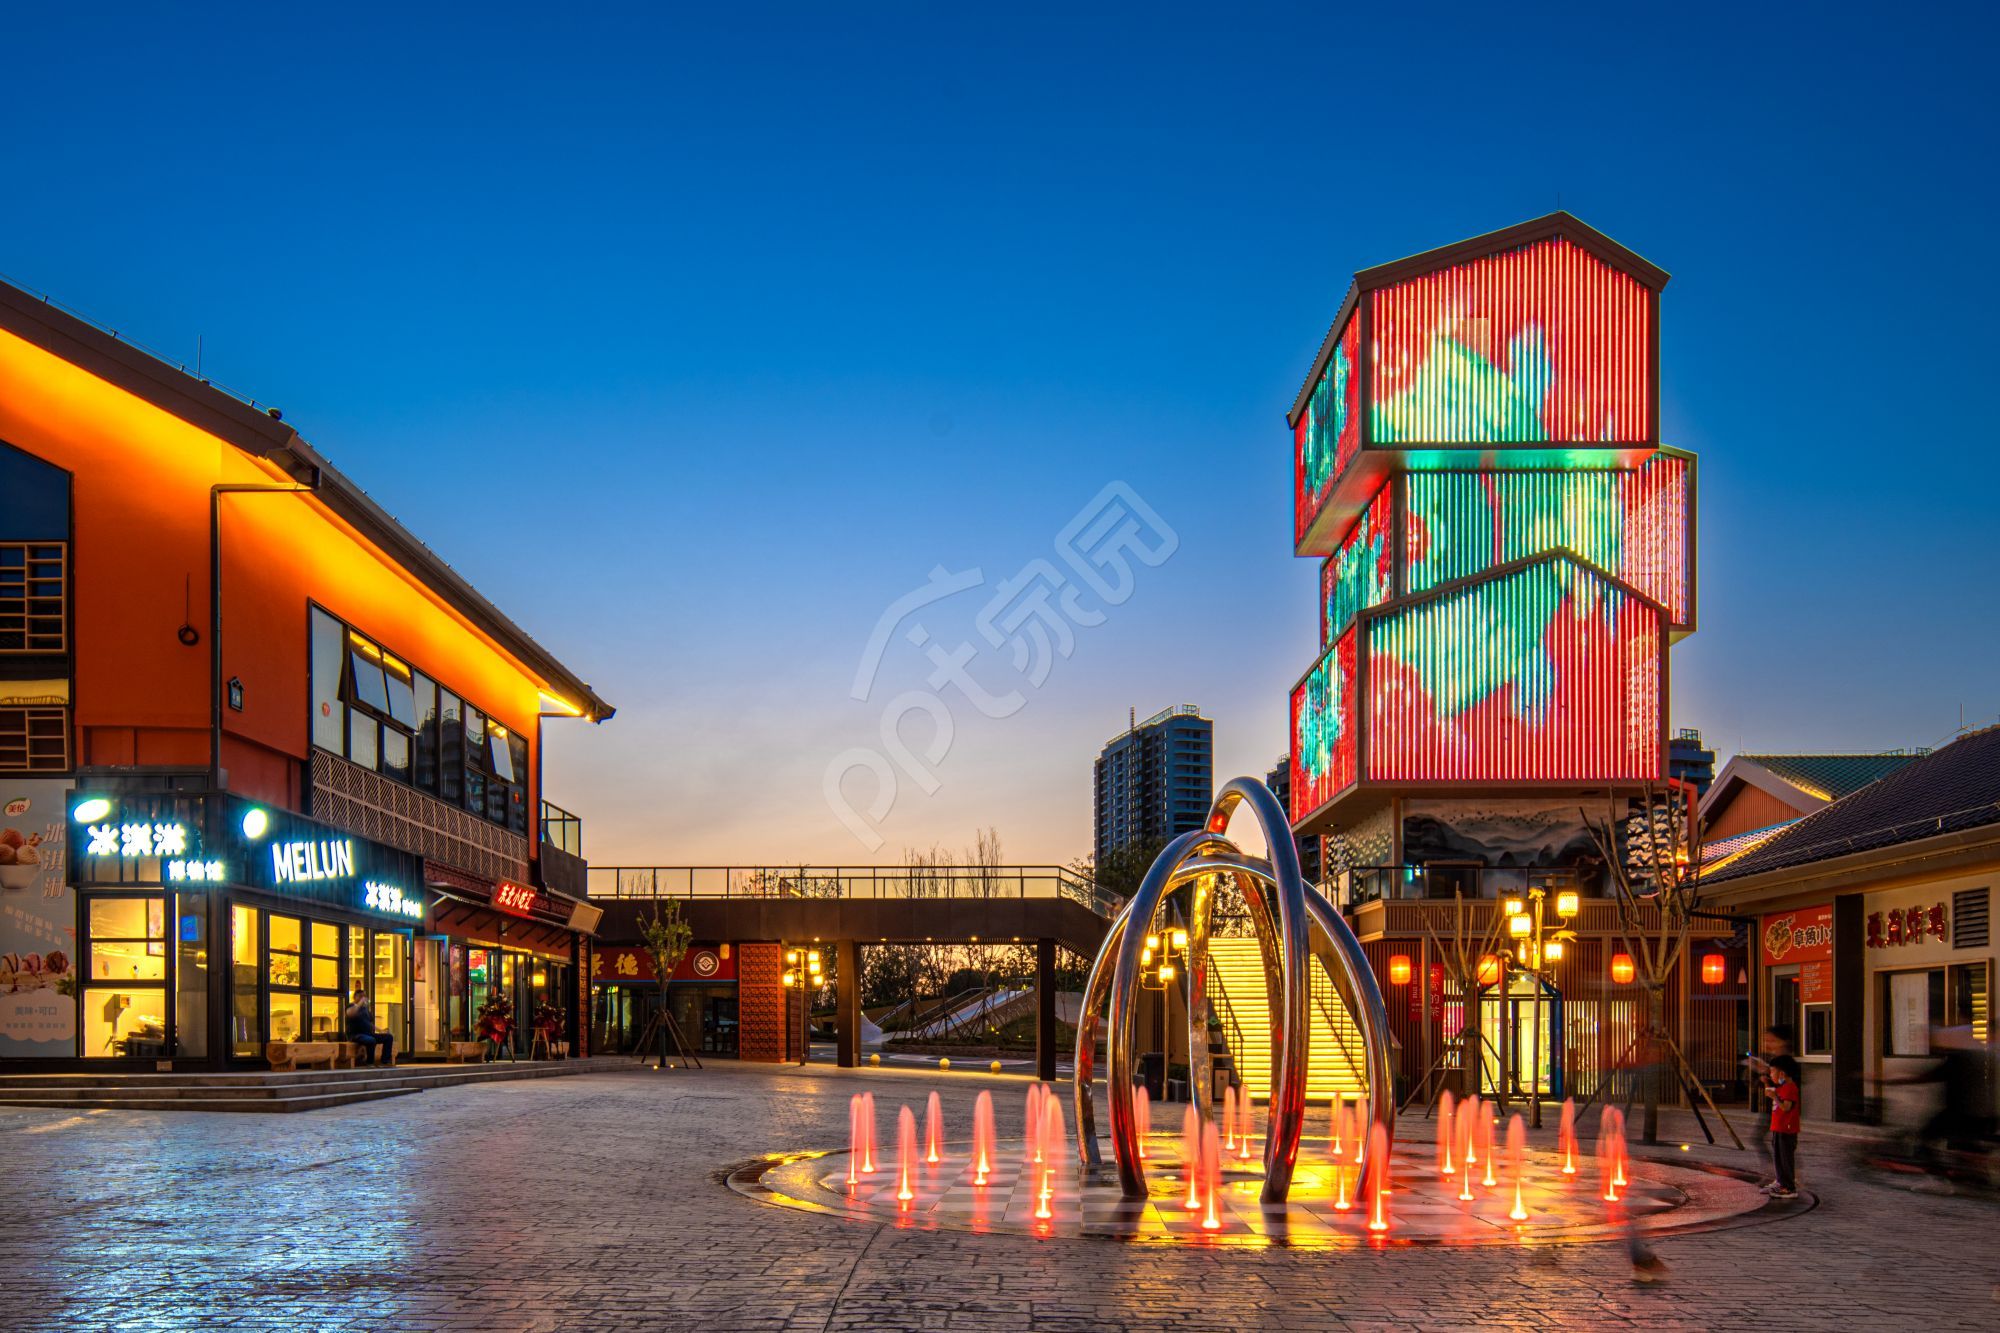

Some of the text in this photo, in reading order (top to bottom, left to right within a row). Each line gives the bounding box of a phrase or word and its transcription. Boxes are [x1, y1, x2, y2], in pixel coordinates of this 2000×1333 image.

[86, 823, 186, 856] 冰淇淋
[271, 839, 355, 884] MEILUN
